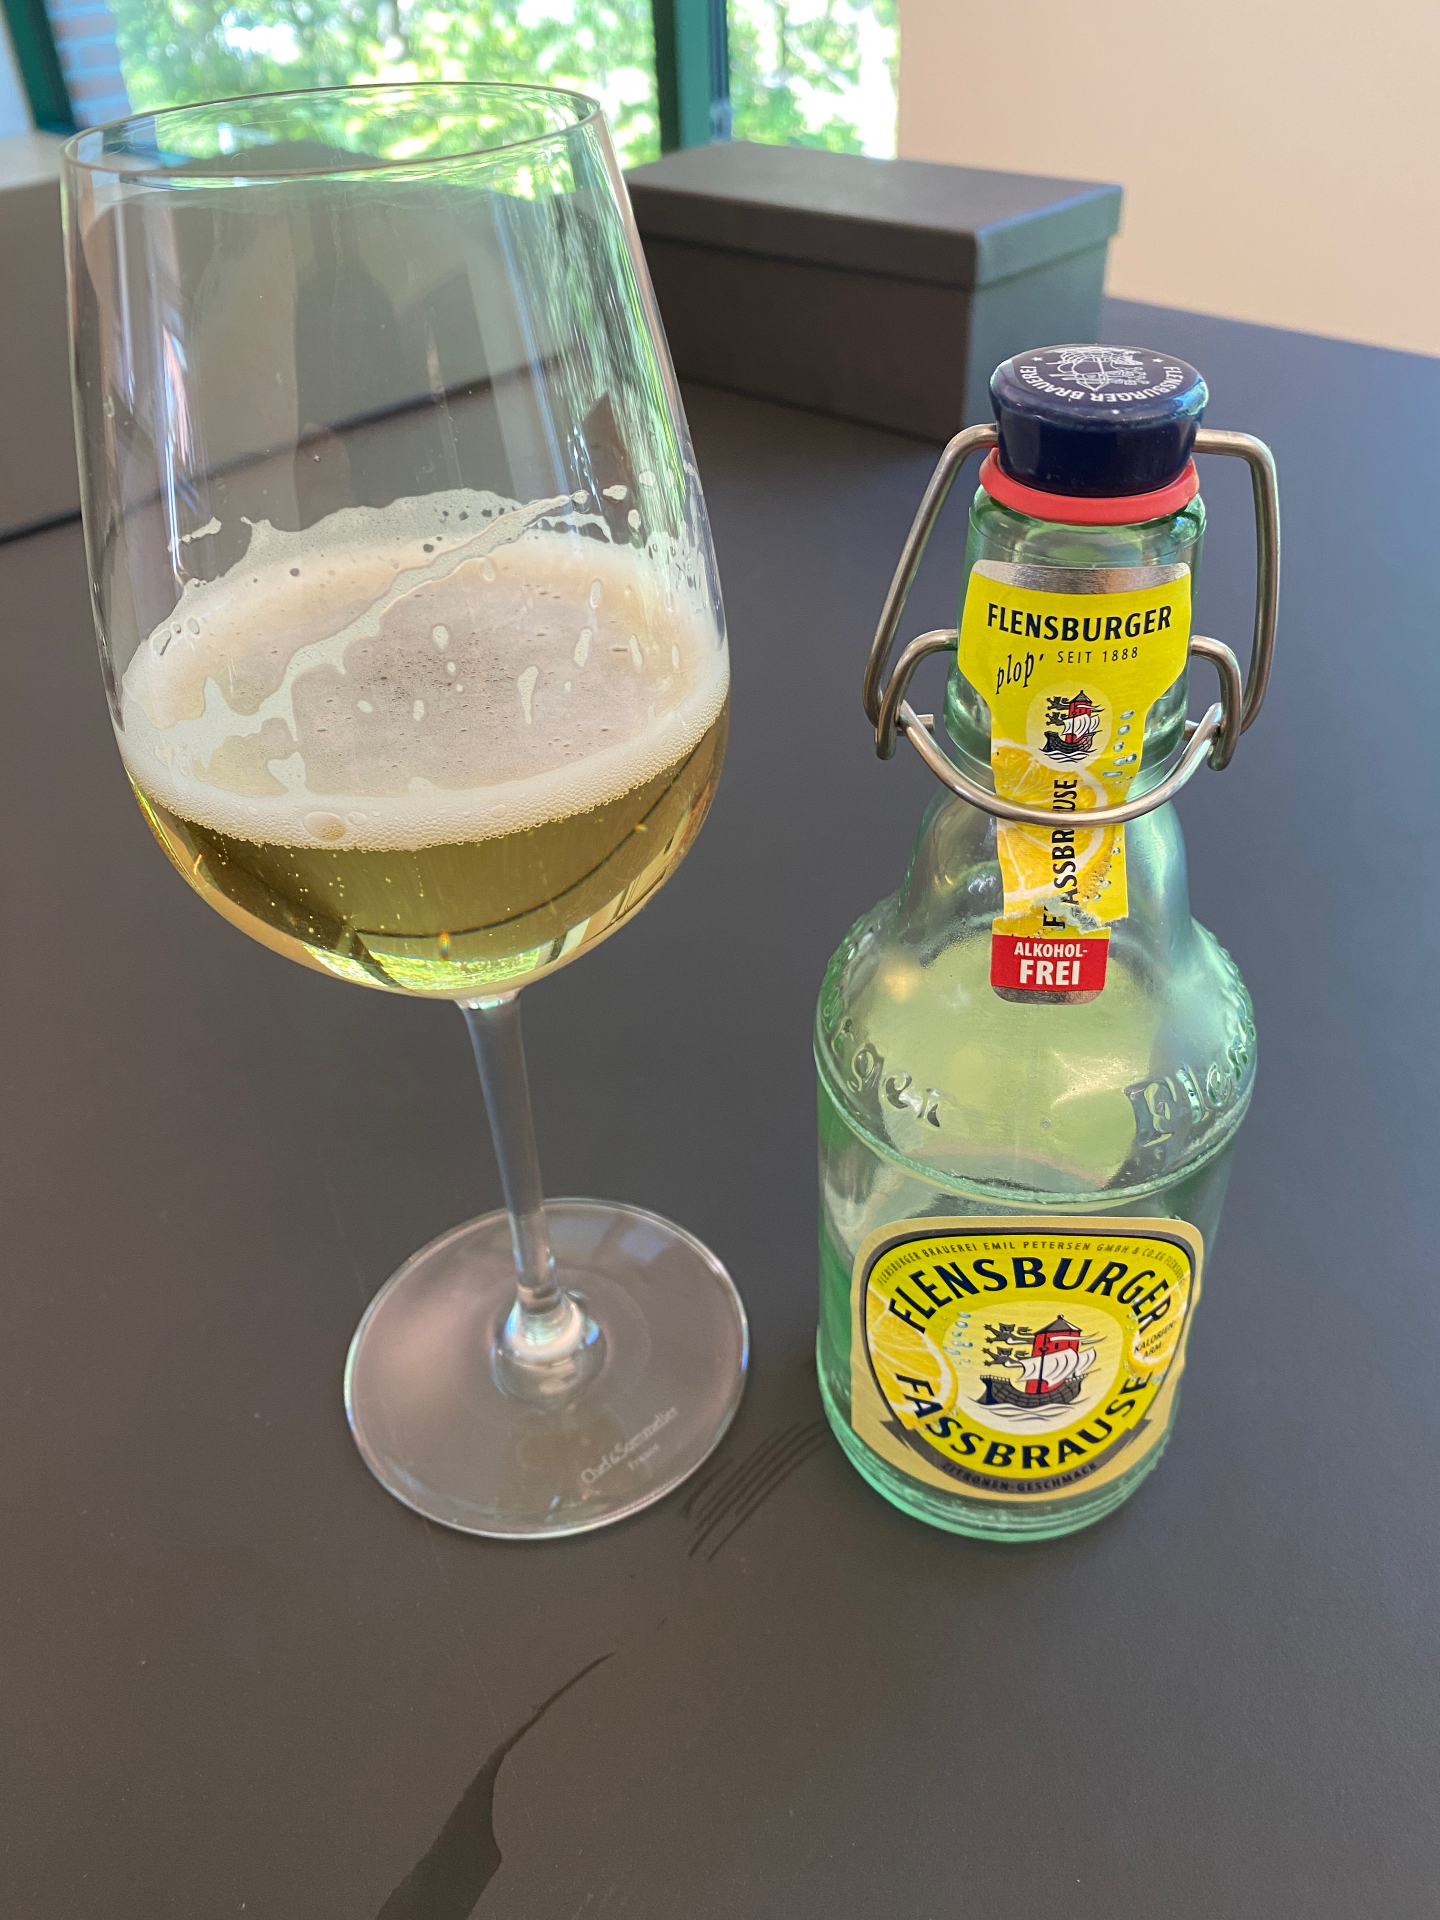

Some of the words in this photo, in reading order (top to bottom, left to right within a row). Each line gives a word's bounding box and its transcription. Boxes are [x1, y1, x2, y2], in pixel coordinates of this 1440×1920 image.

[1020, 365, 1084, 401] BRAUEREI
[1090, 366, 1184, 402] FLENSBURGER
[987, 602, 1172, 642] FLENSBURGER
[1057, 651, 1092, 664] SEIT
[1102, 646, 1139, 663] 1888
[1042, 779, 1079, 929] FASSBRUSE
[1014, 941, 1088, 958] ALKOHOL-
[1019, 959, 1080, 986] FREI
[877, 1251, 922, 1286] FLENSBURGER
[921, 1243, 978, 1257] BRAUEREI
[984, 1241, 1016, 1251] EMIL
[1023, 1241, 1091, 1251] PETERSEN
[888, 1256, 1172, 1335] FLENSBURGER
[895, 1370, 1154, 1469] FASSBRAUSE
